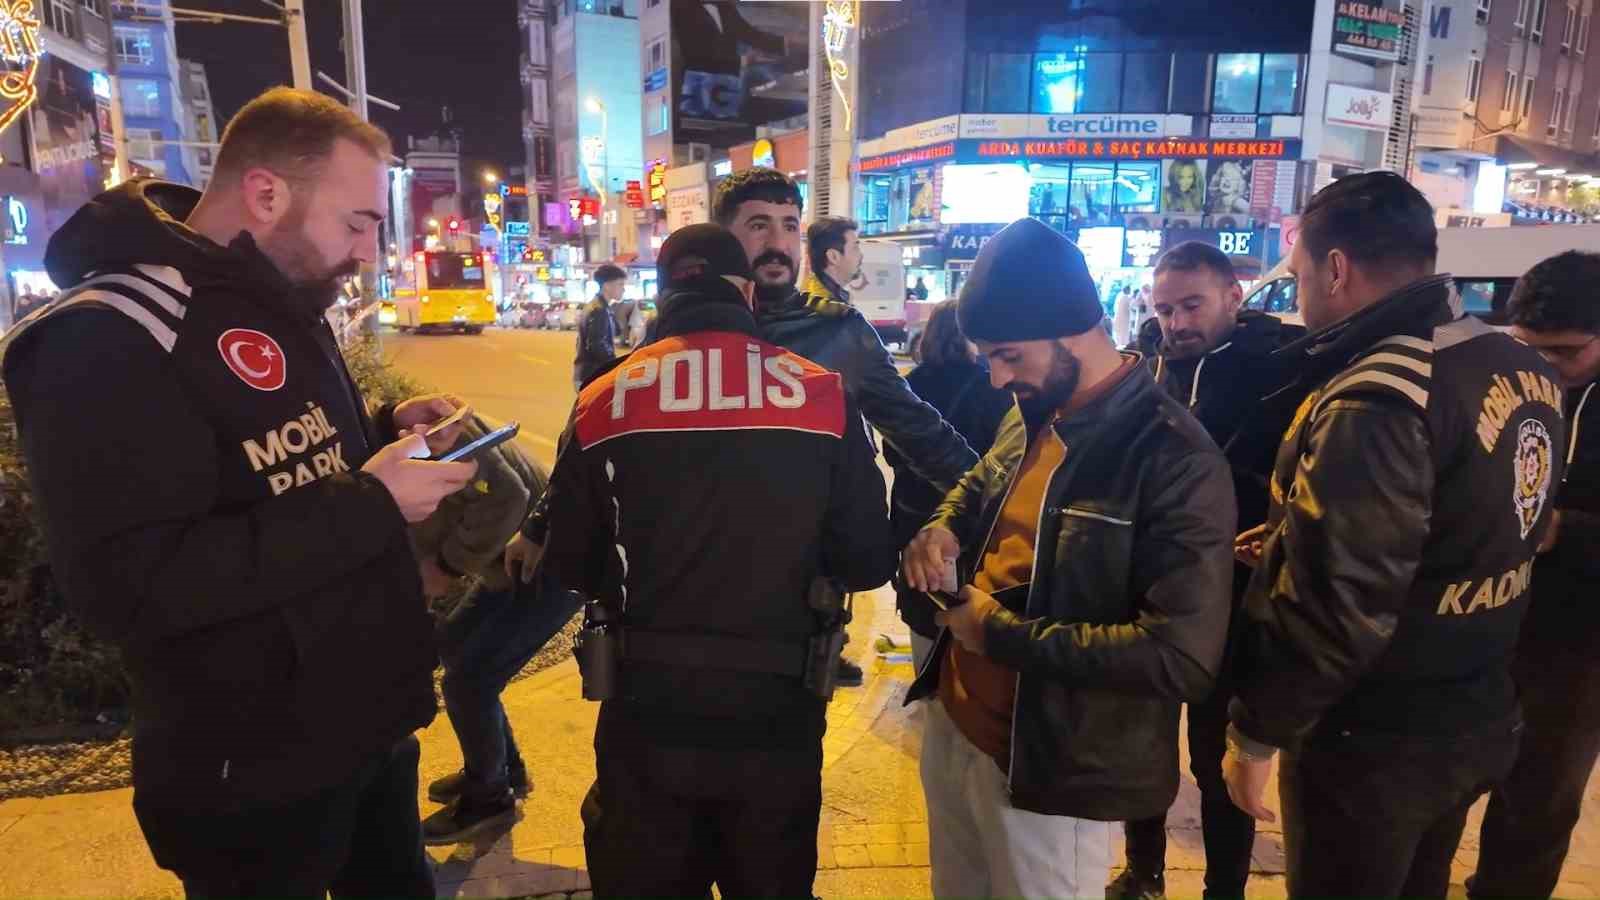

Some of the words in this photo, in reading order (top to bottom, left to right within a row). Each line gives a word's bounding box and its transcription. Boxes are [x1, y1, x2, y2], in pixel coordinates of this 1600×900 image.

[1024, 139, 1088, 156] KUAFÖR
[1110, 141, 1140, 160] SAÇ
[1212, 139, 1285, 156] MERKEZİ
[1047, 115, 1158, 133] tercüme
[1218, 231, 1251, 255] BE
[611, 344, 807, 420] POLİS
[241, 401, 338, 472] MOBİL
[1476, 373, 1523, 454] MOBİL
[267, 442, 351, 496] PARK
